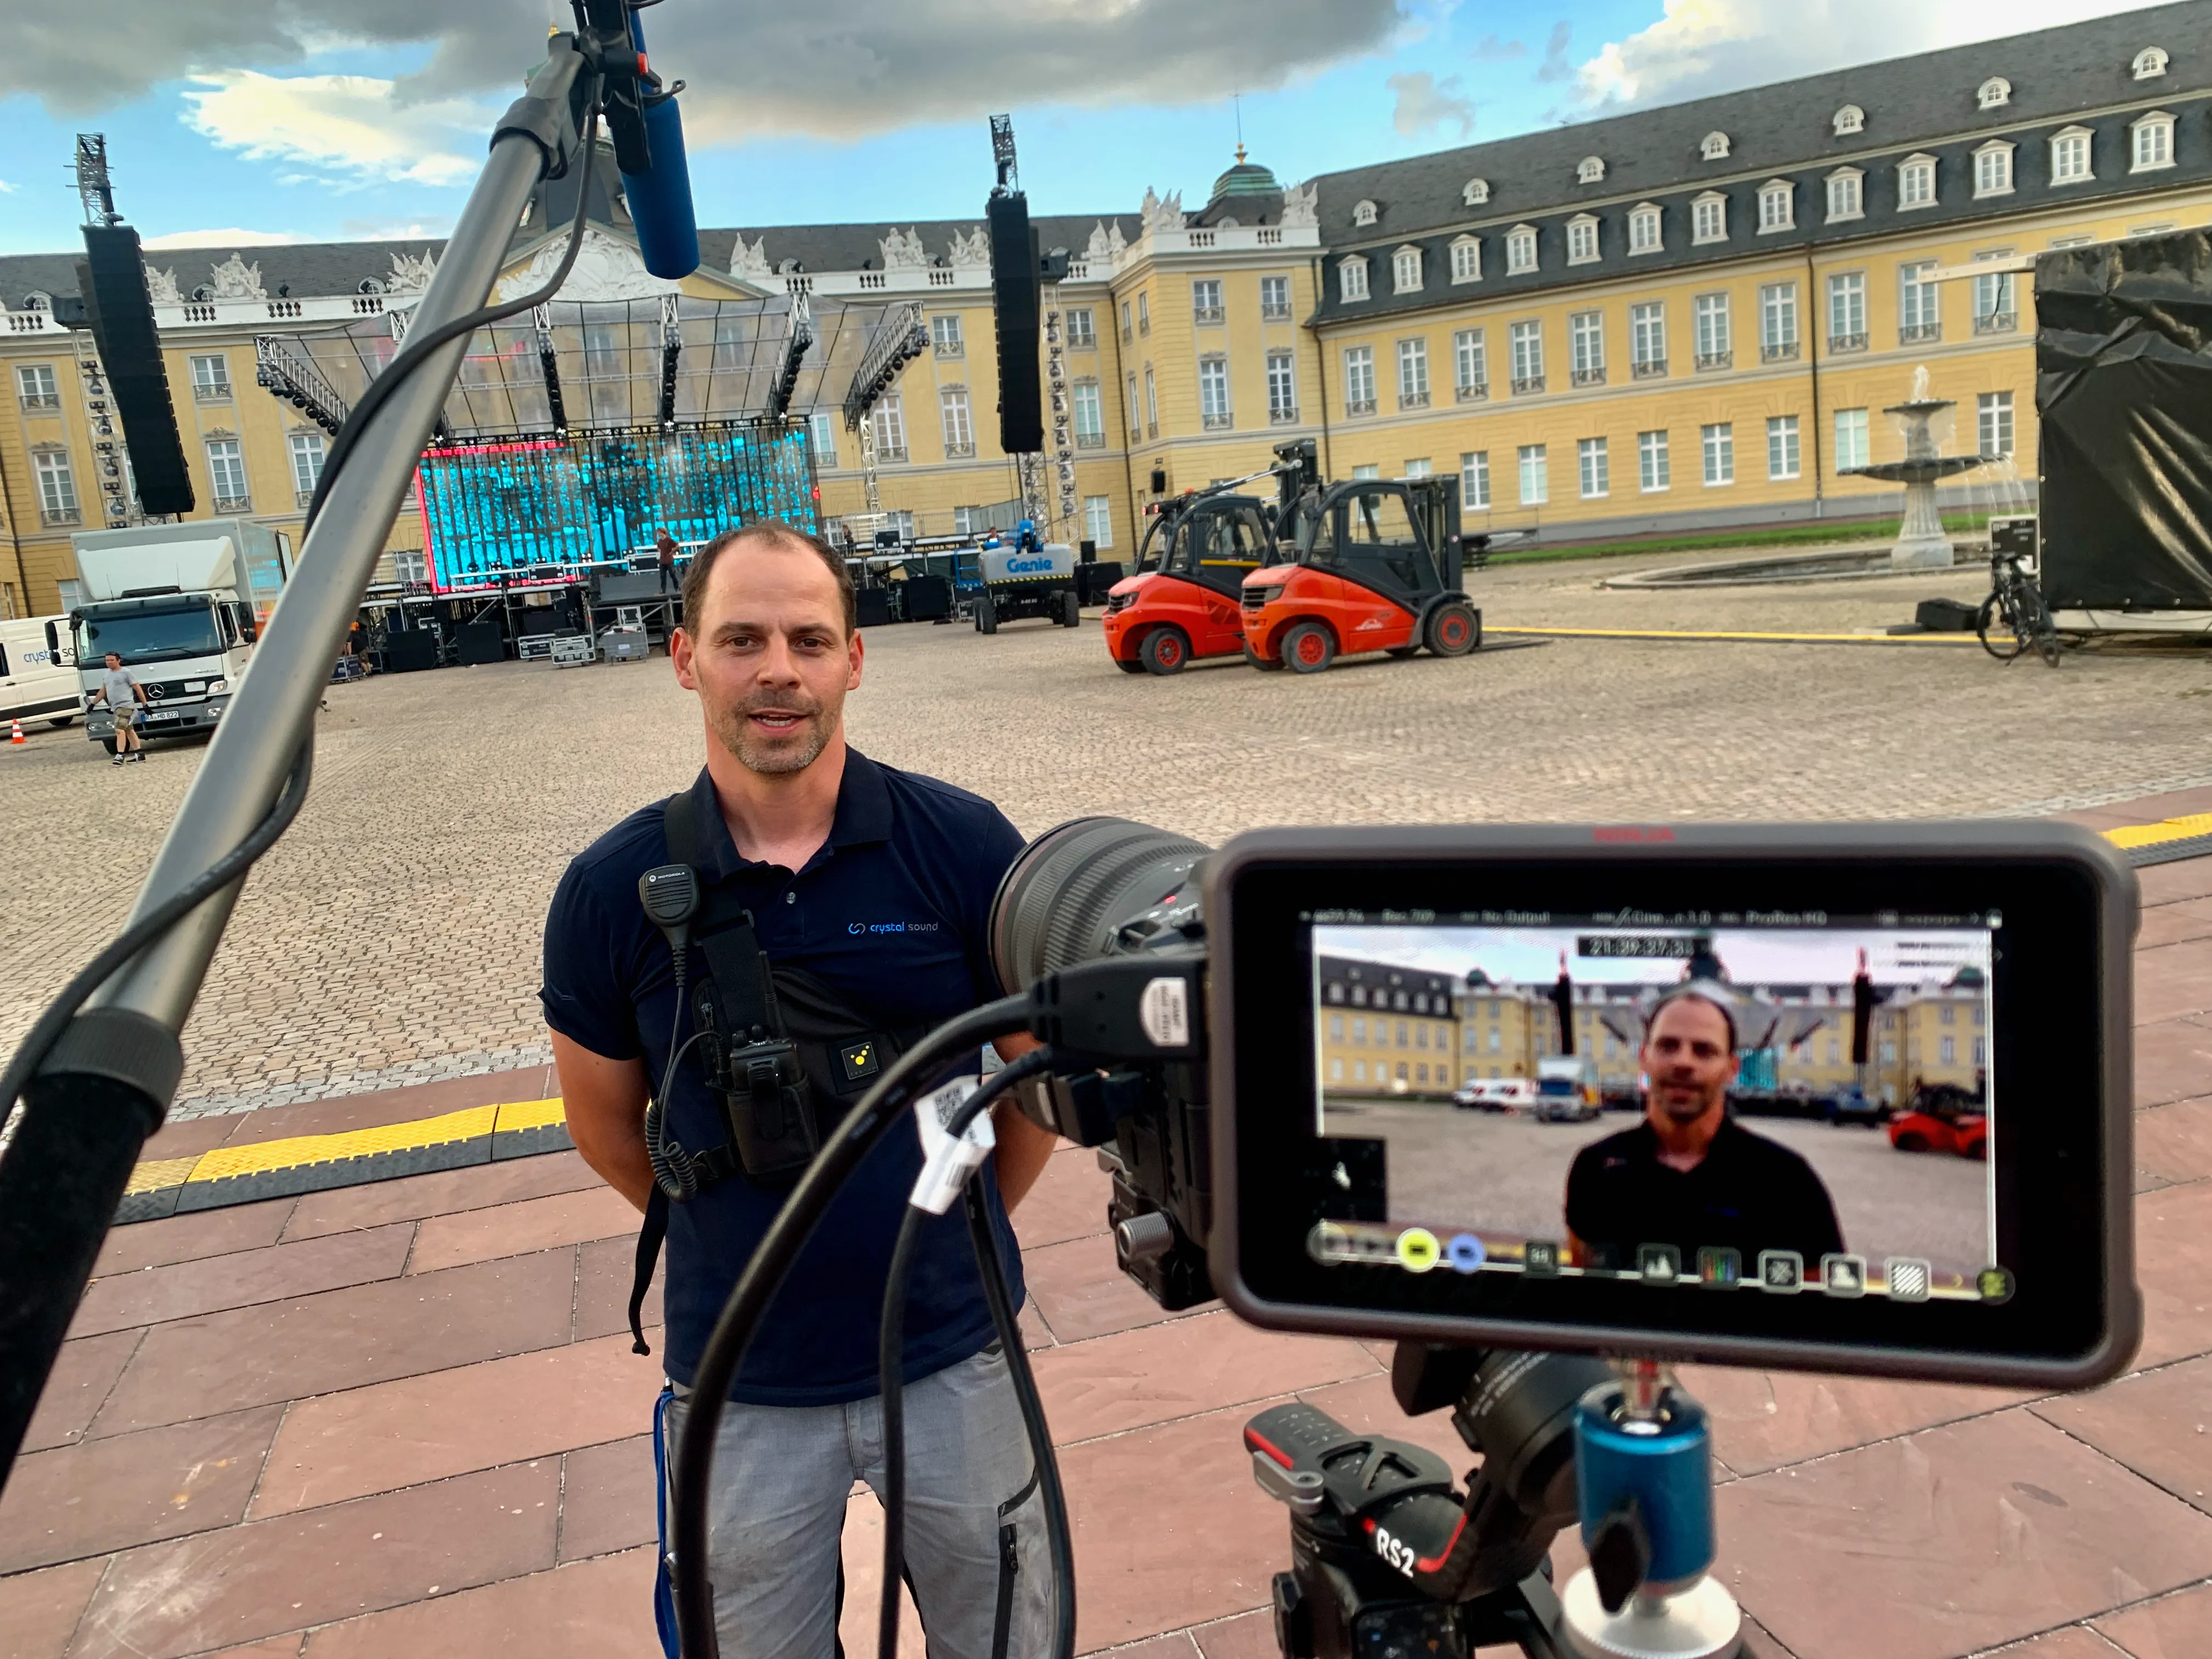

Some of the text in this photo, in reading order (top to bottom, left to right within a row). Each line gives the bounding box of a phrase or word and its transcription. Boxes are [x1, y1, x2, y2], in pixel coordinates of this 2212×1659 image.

[1007, 557, 1053, 573] Genie
[24, 649, 51, 664] cryst
[870, 922, 938, 934] crystal sound
[1377, 1527, 1414, 1578] RS2
